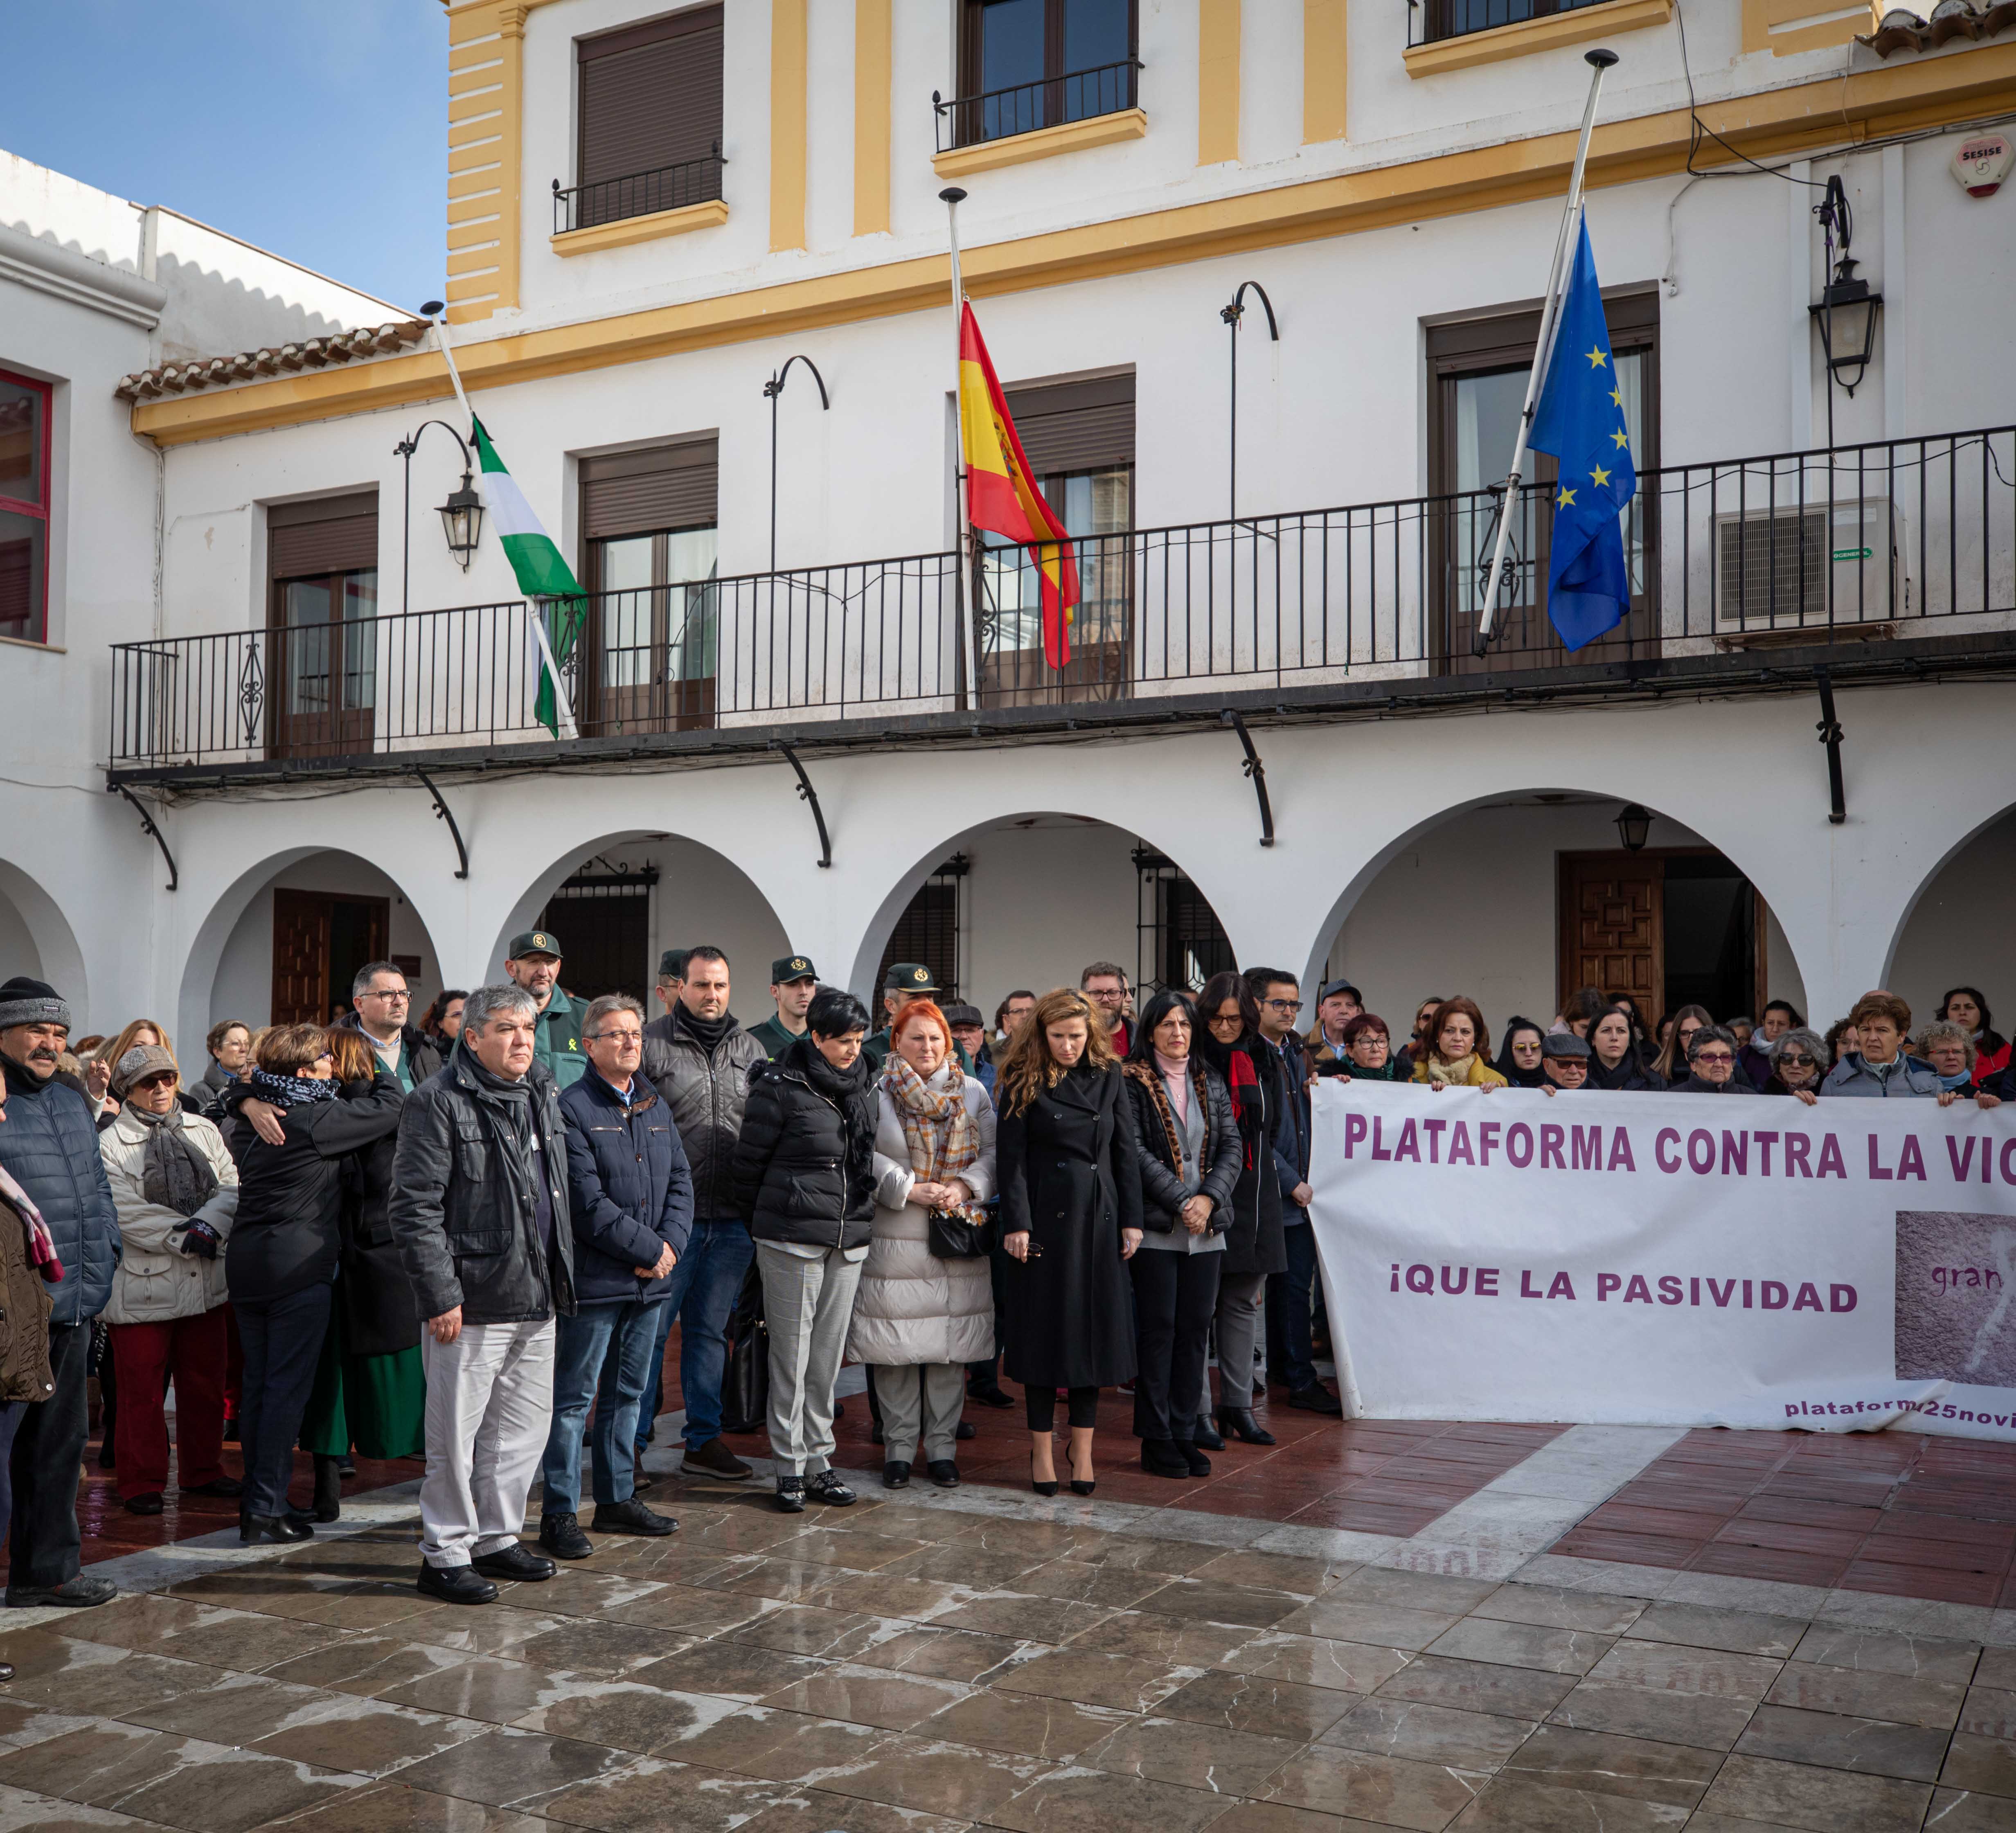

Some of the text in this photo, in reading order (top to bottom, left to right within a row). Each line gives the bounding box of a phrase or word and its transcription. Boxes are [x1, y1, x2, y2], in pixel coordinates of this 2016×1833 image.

[1963, 146, 2002, 160] SESISE
[1344, 1113, 1636, 1172] PLATAFORMA
[1655, 1127, 1847, 1179] CONTRA
[1868, 1134, 1927, 1181] LA
[1390, 1263, 1858, 1313] ¡QUE LA PASIVIDAD
[1930, 1266, 2002, 1297] gran
